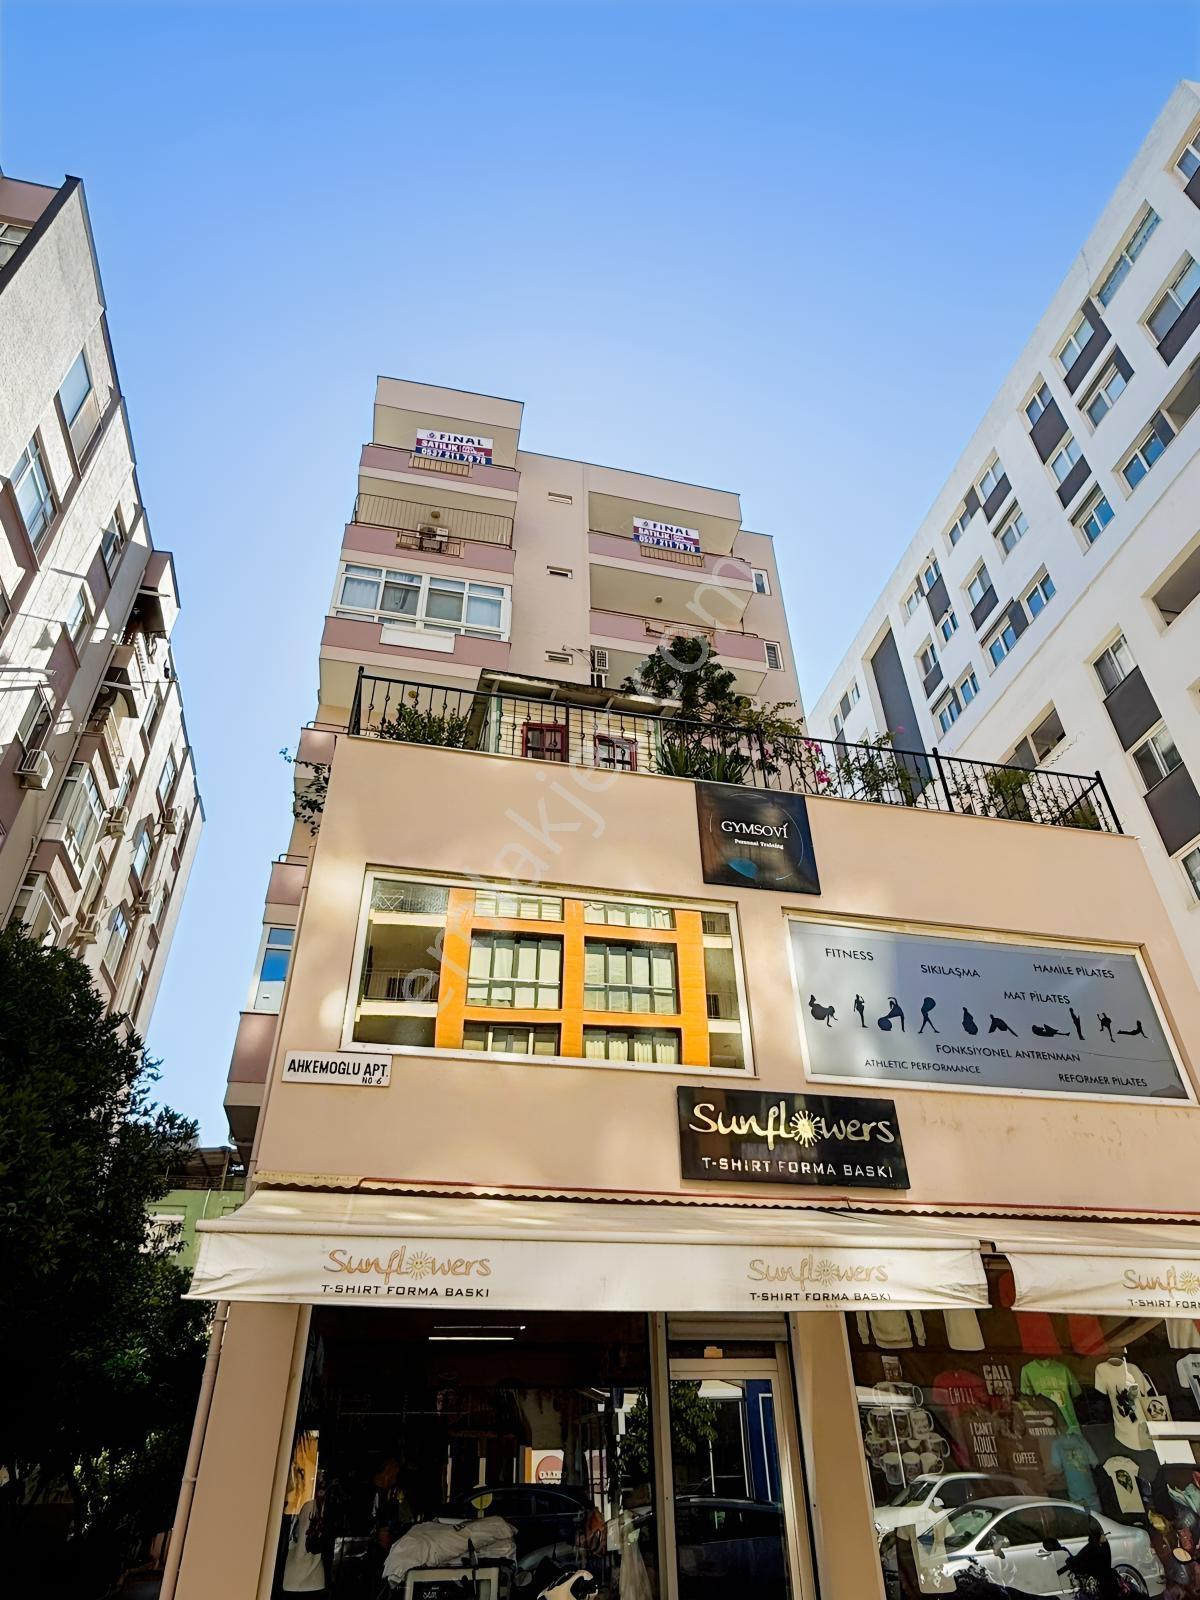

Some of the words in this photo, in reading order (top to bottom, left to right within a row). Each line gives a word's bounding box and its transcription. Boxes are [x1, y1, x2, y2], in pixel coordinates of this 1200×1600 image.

[421, 438, 459, 452] SATILIK
[734, 838, 759, 846] Personal
[760, 841, 785, 850] Training
[825, 947, 874, 961] FITNESS
[920, 964, 981, 979] SIKILAŞMA
[1033, 963, 1074, 976] HAMİLE
[1076, 965, 1115, 979] PİLATES
[1003, 991, 1026, 1001] MAT
[1029, 991, 1071, 1004] PİLATES
[935, 1043, 1012, 1059] FONKSİYONEL
[1015, 1050, 1081, 1062] ANTRENMAN
[865, 1059, 909, 1070] ATHLETIC
[911, 1061, 981, 1074] PERFORMANCE
[376, 1077, 382, 1085] 6
[1058, 1073, 1109, 1085] REFORMER
[1112, 1074, 1148, 1087] PİLATES
[689, 1100, 895, 1151] Sunflowers
[702, 1157, 771, 1173] T-SHIRT
[778, 1160, 836, 1176] FORMA
[843, 1165, 893, 1179] BASKI
[324, 1245, 492, 1286] Sunflowers
[747, 1253, 889, 1292] Sunflowers
[321, 1284, 381, 1295] T-SHIRT
[386, 1286, 439, 1297] FORMA
[445, 1288, 489, 1298] BASKI
[749, 1292, 801, 1301] T-SHIRT
[805, 1292, 850, 1301] FORMA
[854, 1293, 891, 1301] BASKI
[1128, 1299, 1171, 1308] T-SHIRT
[982, 1364, 1012, 1380] CALI
[948, 1387, 976, 1405] CHILL
[969, 1422, 974, 1436] I
[973, 1436, 998, 1453] ADULT
[976, 1454, 999, 1468] TODAY
[1012, 1451, 1038, 1464] COFFEE
